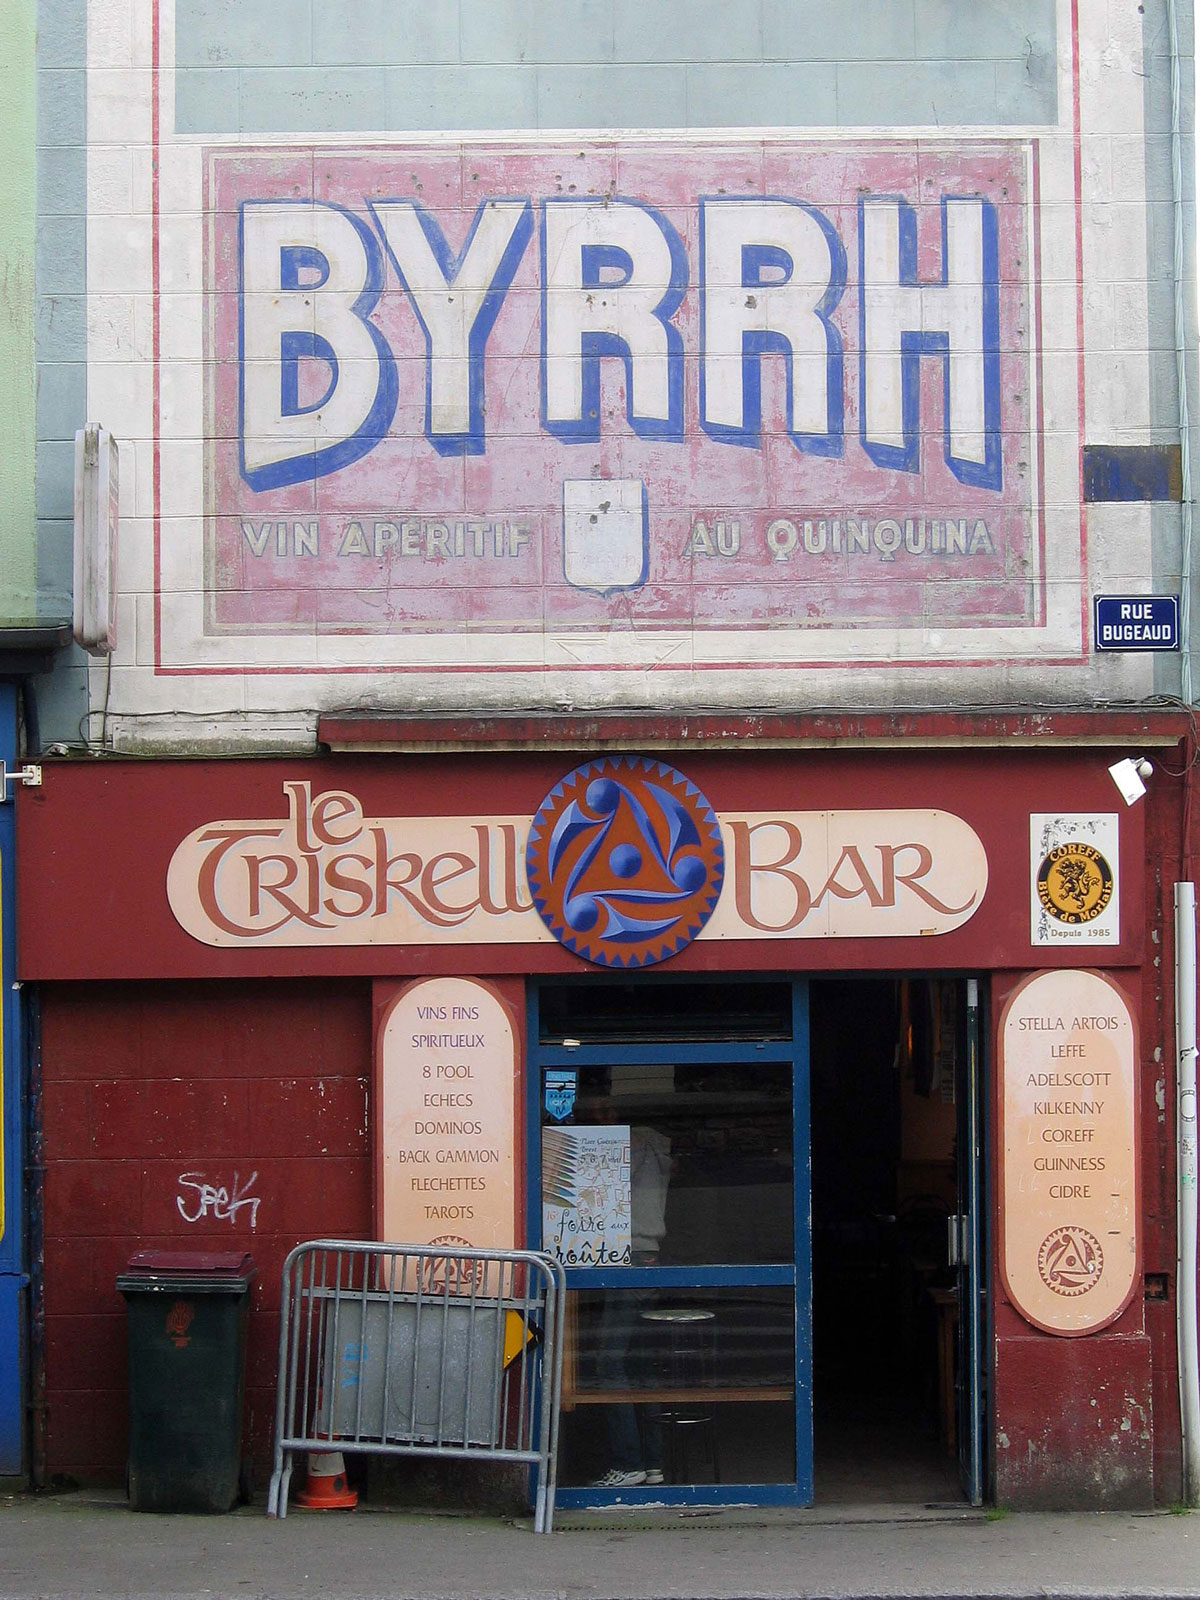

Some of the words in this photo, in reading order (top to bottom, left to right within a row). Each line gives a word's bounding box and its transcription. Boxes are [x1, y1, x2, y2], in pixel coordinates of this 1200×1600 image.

[239, 194, 1002, 492] BYRRH
[241, 520, 320, 558] VIN
[682, 518, 741, 557] AU
[766, 518, 996, 564] QUINQUINA
[1120, 603, 1153, 620] RUE
[1102, 624, 1171, 641] BUGEAUD
[1050, 844, 1100, 862] COREFF
[1038, 881, 1058, 915] Bière
[1060, 912, 1076, 923] de
[1079, 881, 1112, 923] Morlaix
[1051, 928, 1082, 938] Depuis
[1087, 928, 1111, 937] 1985
[417, 1006, 447, 1020] VINS
[452, 1006, 479, 1020] FINS
[1018, 1017, 1065, 1031] STELLA
[1071, 1016, 1119, 1030] ARTOIS
[412, 1034, 485, 1048] SPIRITUEUX
[1051, 1044, 1087, 1058] LEFFE
[422, 1065, 431, 1079] 8
[436, 1065, 474, 1079] POOL
[1026, 1072, 1111, 1087] ADELSCOTT
[423, 1093, 473, 1107] ECHECS
[1033, 1101, 1104, 1115] KILKENNY
[414, 1121, 482, 1135] DOMINOS
[1042, 1129, 1095, 1143] COREFF
[399, 1150, 430, 1163] BACK
[435, 1149, 499, 1163] GAMMON
[1033, 1157, 1106, 1171] GUINNESS
[411, 1177, 486, 1191] FLECHETTES
[1049, 1184, 1092, 1199] CIDRE
[424, 1205, 474, 1219] TAROTS
[554, 1208, 606, 1244] foire
[611, 1222, 629, 1230] aux
